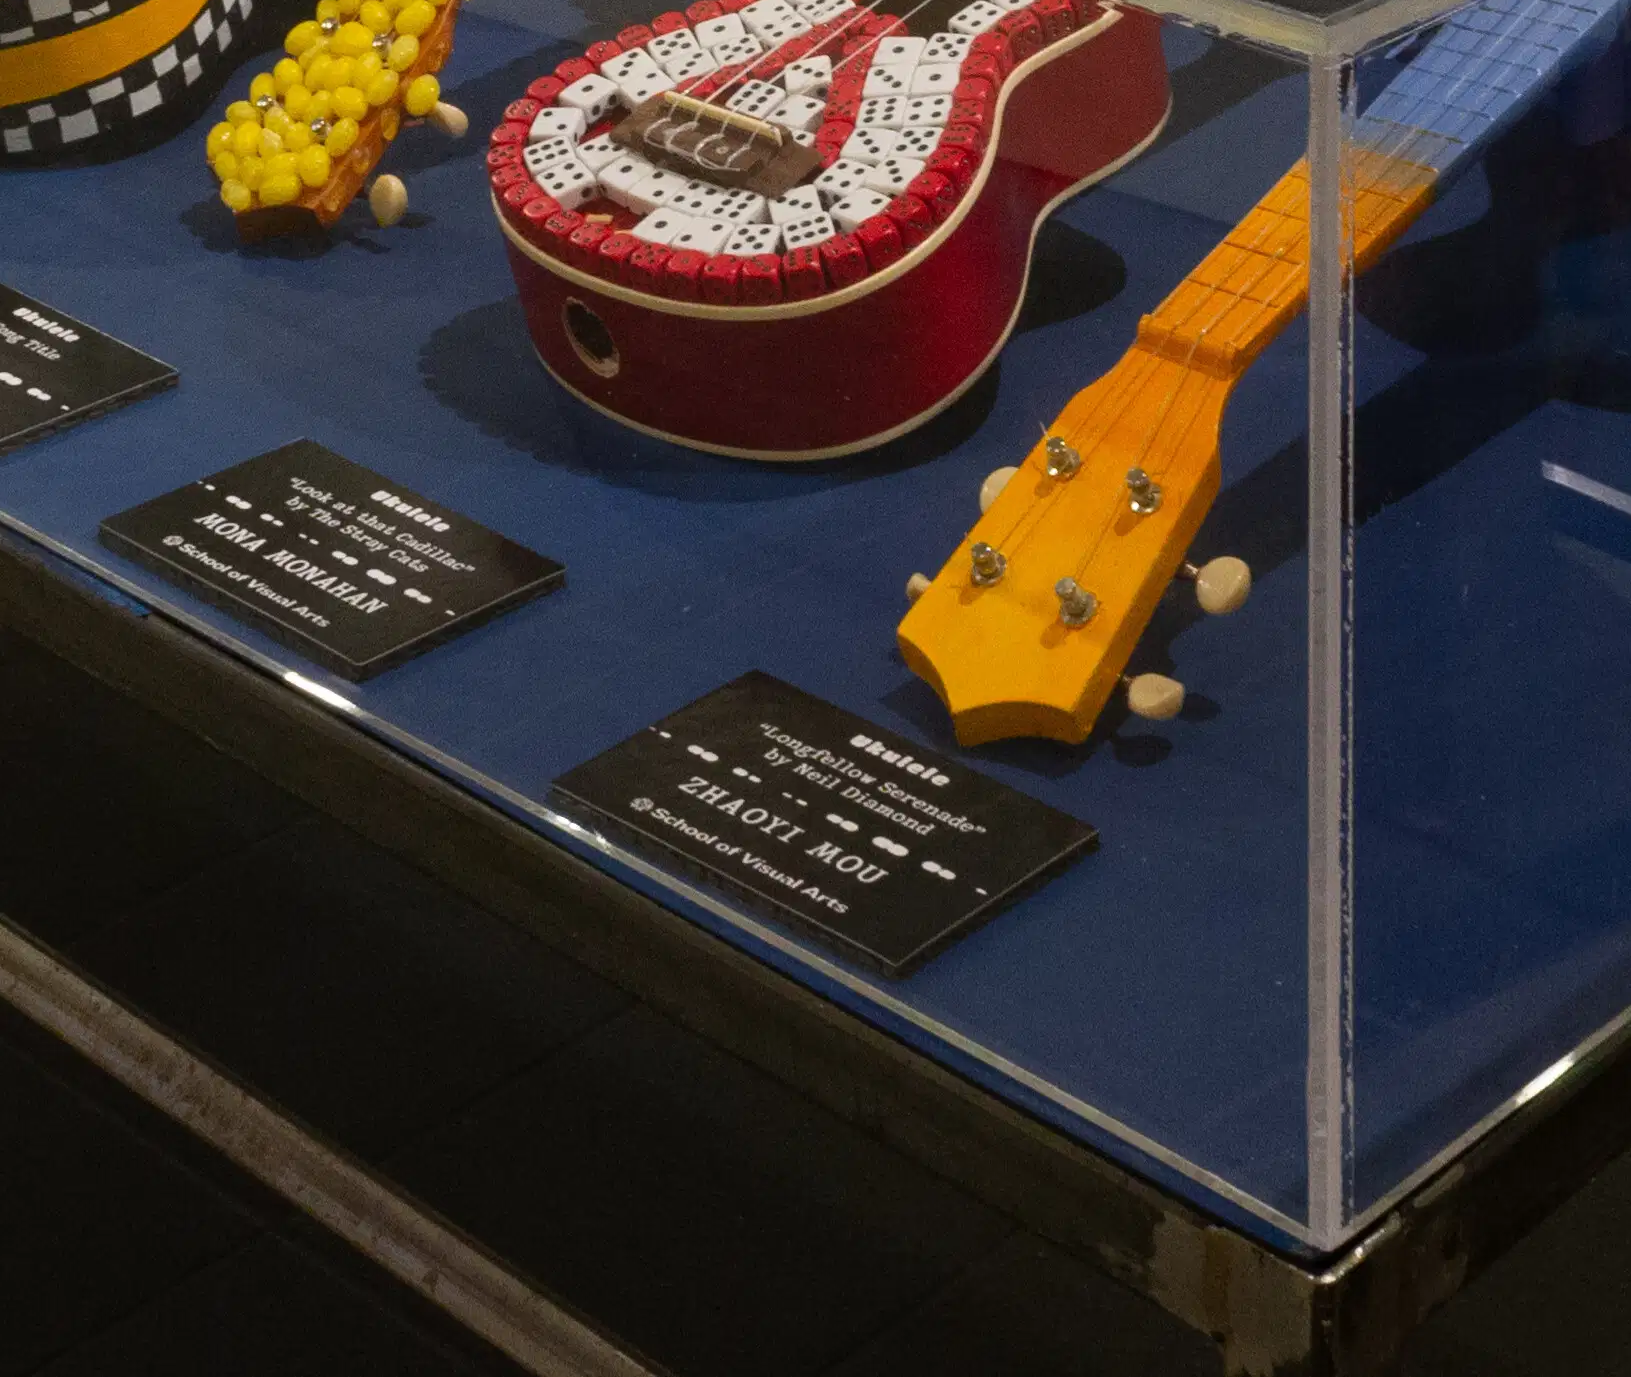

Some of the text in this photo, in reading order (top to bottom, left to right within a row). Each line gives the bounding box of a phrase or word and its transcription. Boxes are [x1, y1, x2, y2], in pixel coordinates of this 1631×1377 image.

[23, 339, 61, 360] Title
[285, 495, 429, 573] by The Stray Cats
[332, 502, 356, 515] at
[356, 512, 397, 536] that
[178, 543, 330, 628] School of Visual Arts
[194, 512, 388, 614] MONA MONAHAN
[677, 776, 889, 883] ZHAOYI MOU
[763, 747, 936, 836] by Neil Diamond
[650, 807, 849, 913] School of Visual Arts
